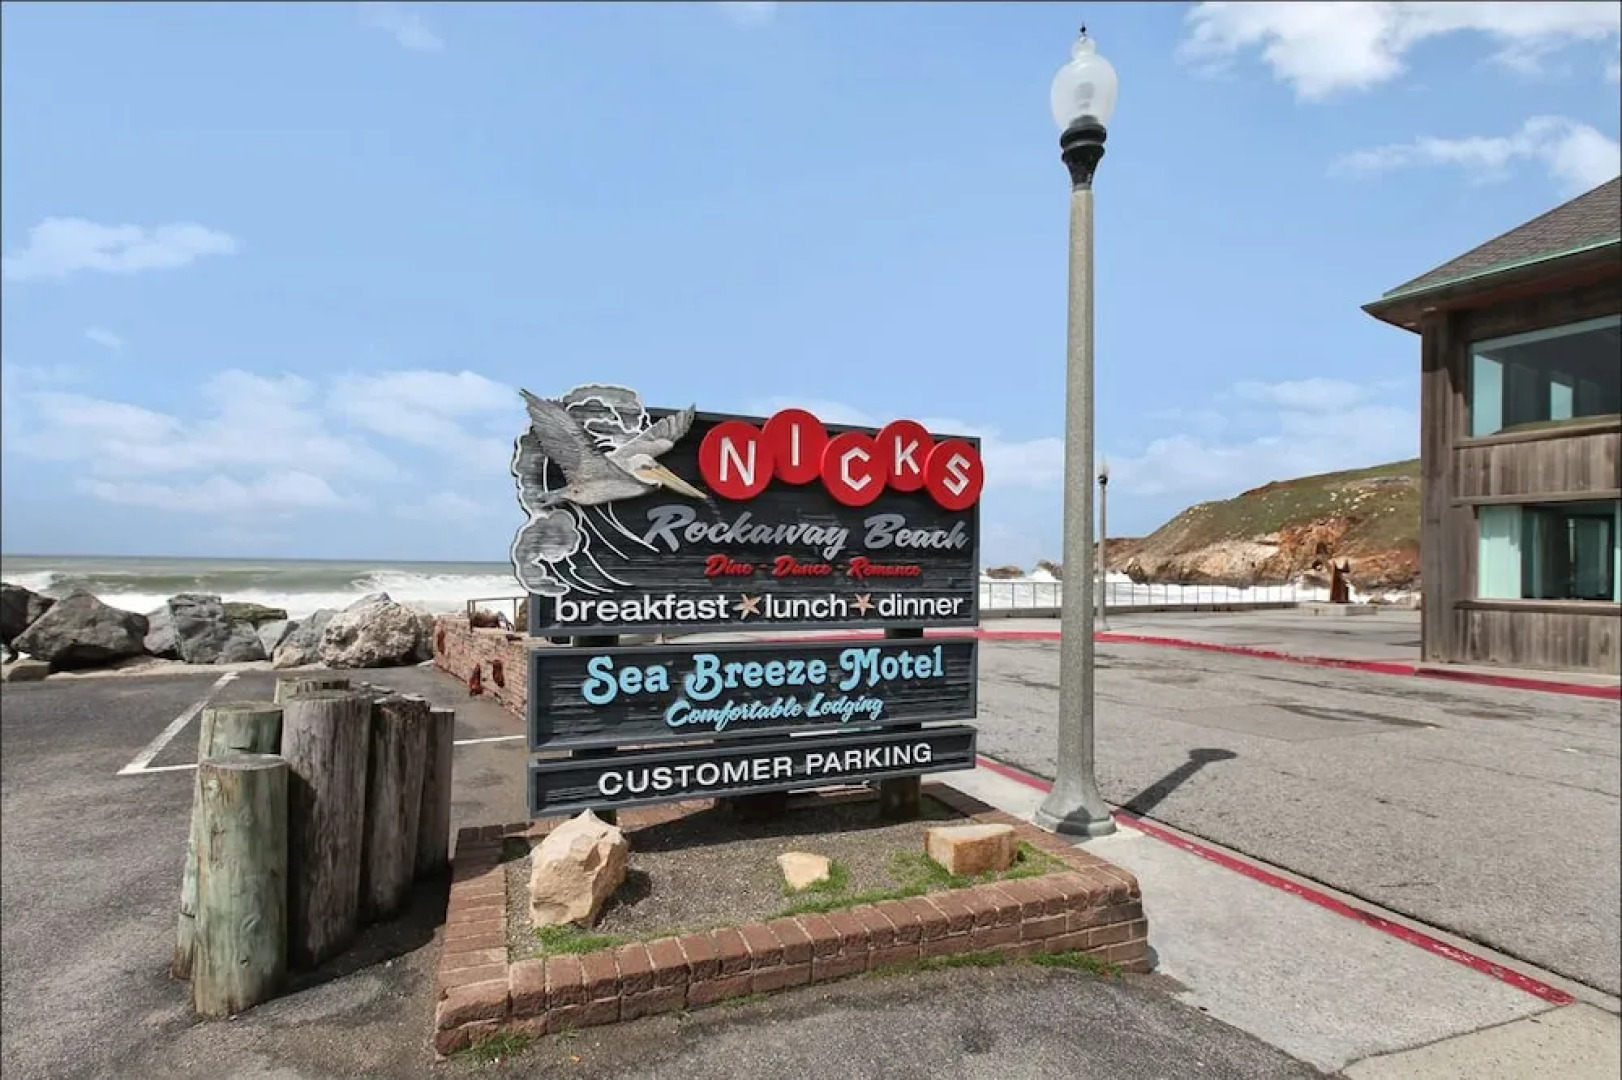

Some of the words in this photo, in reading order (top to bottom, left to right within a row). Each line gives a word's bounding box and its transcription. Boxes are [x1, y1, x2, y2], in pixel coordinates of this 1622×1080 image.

[719, 422, 972, 497] NICKS
[643, 505, 847, 560] Rockaway
[863, 514, 969, 552] Beach
[704, 554, 753, 577] Dine
[773, 555, 831, 577] Dance
[847, 556, 922, 578] Romance
[555, 592, 730, 623] breakfast
[766, 593, 848, 619] lunch
[878, 593, 964, 618] dinner
[582, 656, 670, 705] Sea
[685, 653, 828, 701] Breeze
[839, 645, 945, 691] Motel
[665, 697, 802, 732] Comfortable
[805, 692, 884, 722] Lodging
[598, 757, 793, 797] CUSTOMER
[805, 742, 933, 781] PARKING
